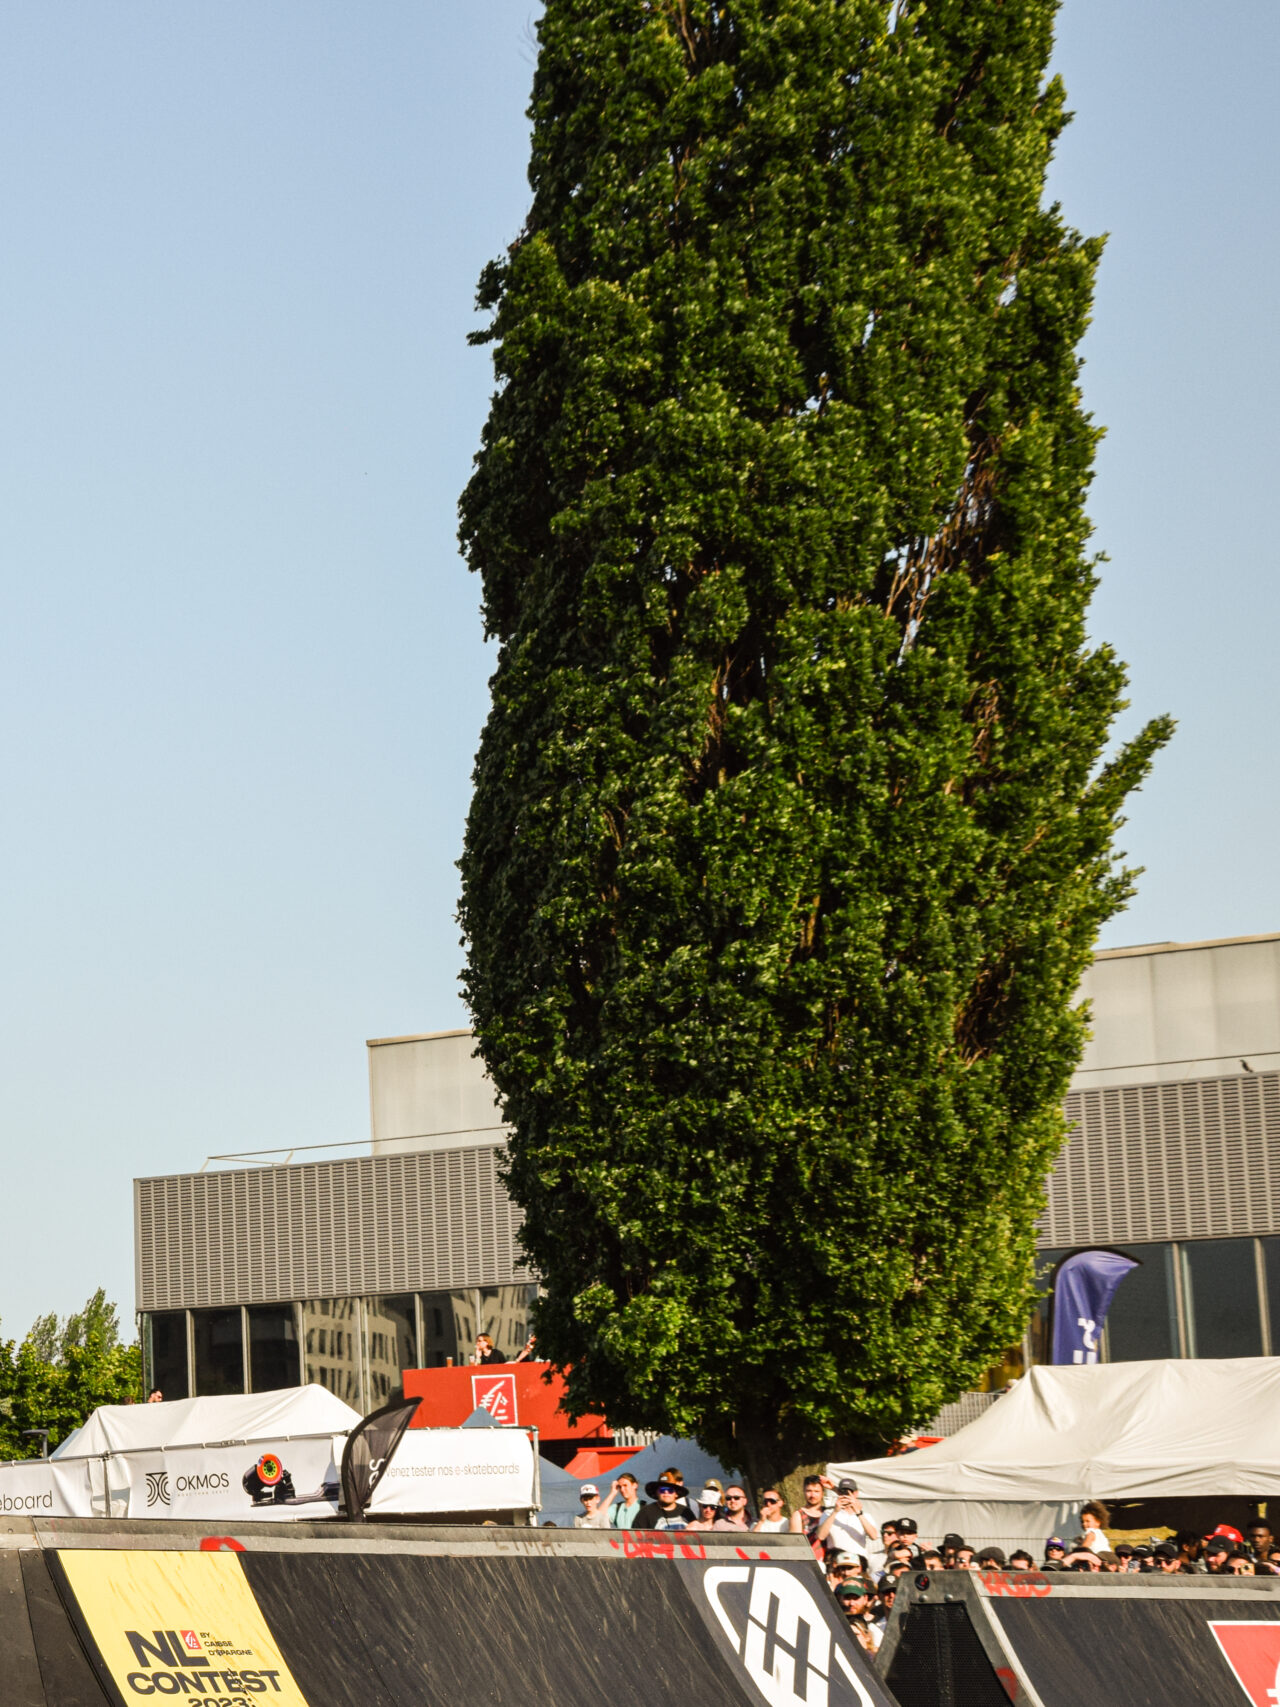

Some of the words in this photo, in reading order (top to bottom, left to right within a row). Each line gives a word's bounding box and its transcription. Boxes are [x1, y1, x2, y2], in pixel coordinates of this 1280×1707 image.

[411, 1464, 435, 1477] tester
[437, 1465, 453, 1475] nos
[455, 1463, 519, 1477] e-skateboards
[176, 1472, 230, 1491] OKMOS
[124, 1630, 211, 1668] NL
[126, 1670, 283, 1696] CONTEST
